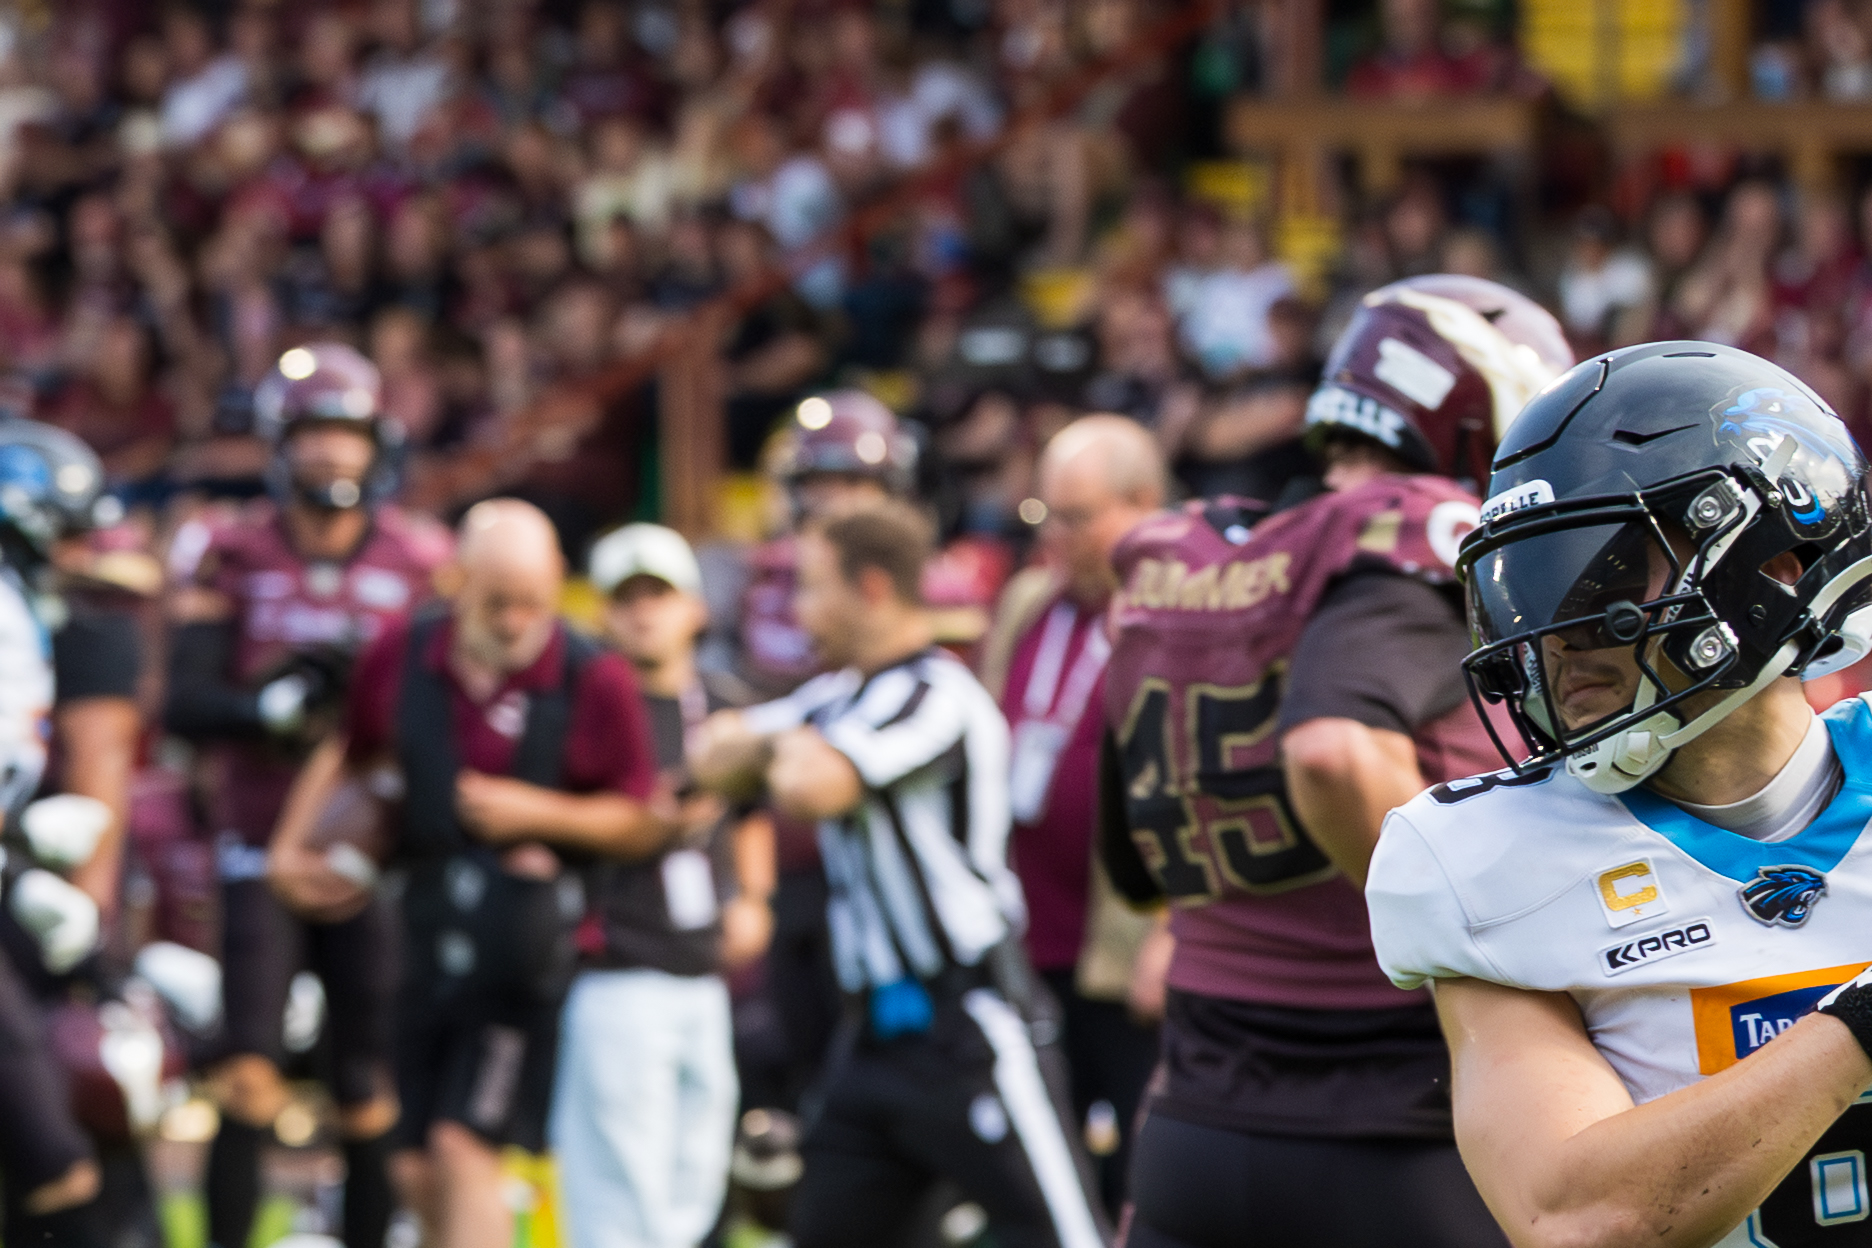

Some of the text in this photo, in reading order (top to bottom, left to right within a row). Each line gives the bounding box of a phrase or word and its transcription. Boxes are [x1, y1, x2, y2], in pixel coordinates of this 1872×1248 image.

[1598, 862, 1658, 912] C
[1606, 923, 1711, 969] KPRO
[1739, 1012, 1806, 1048] TAR
